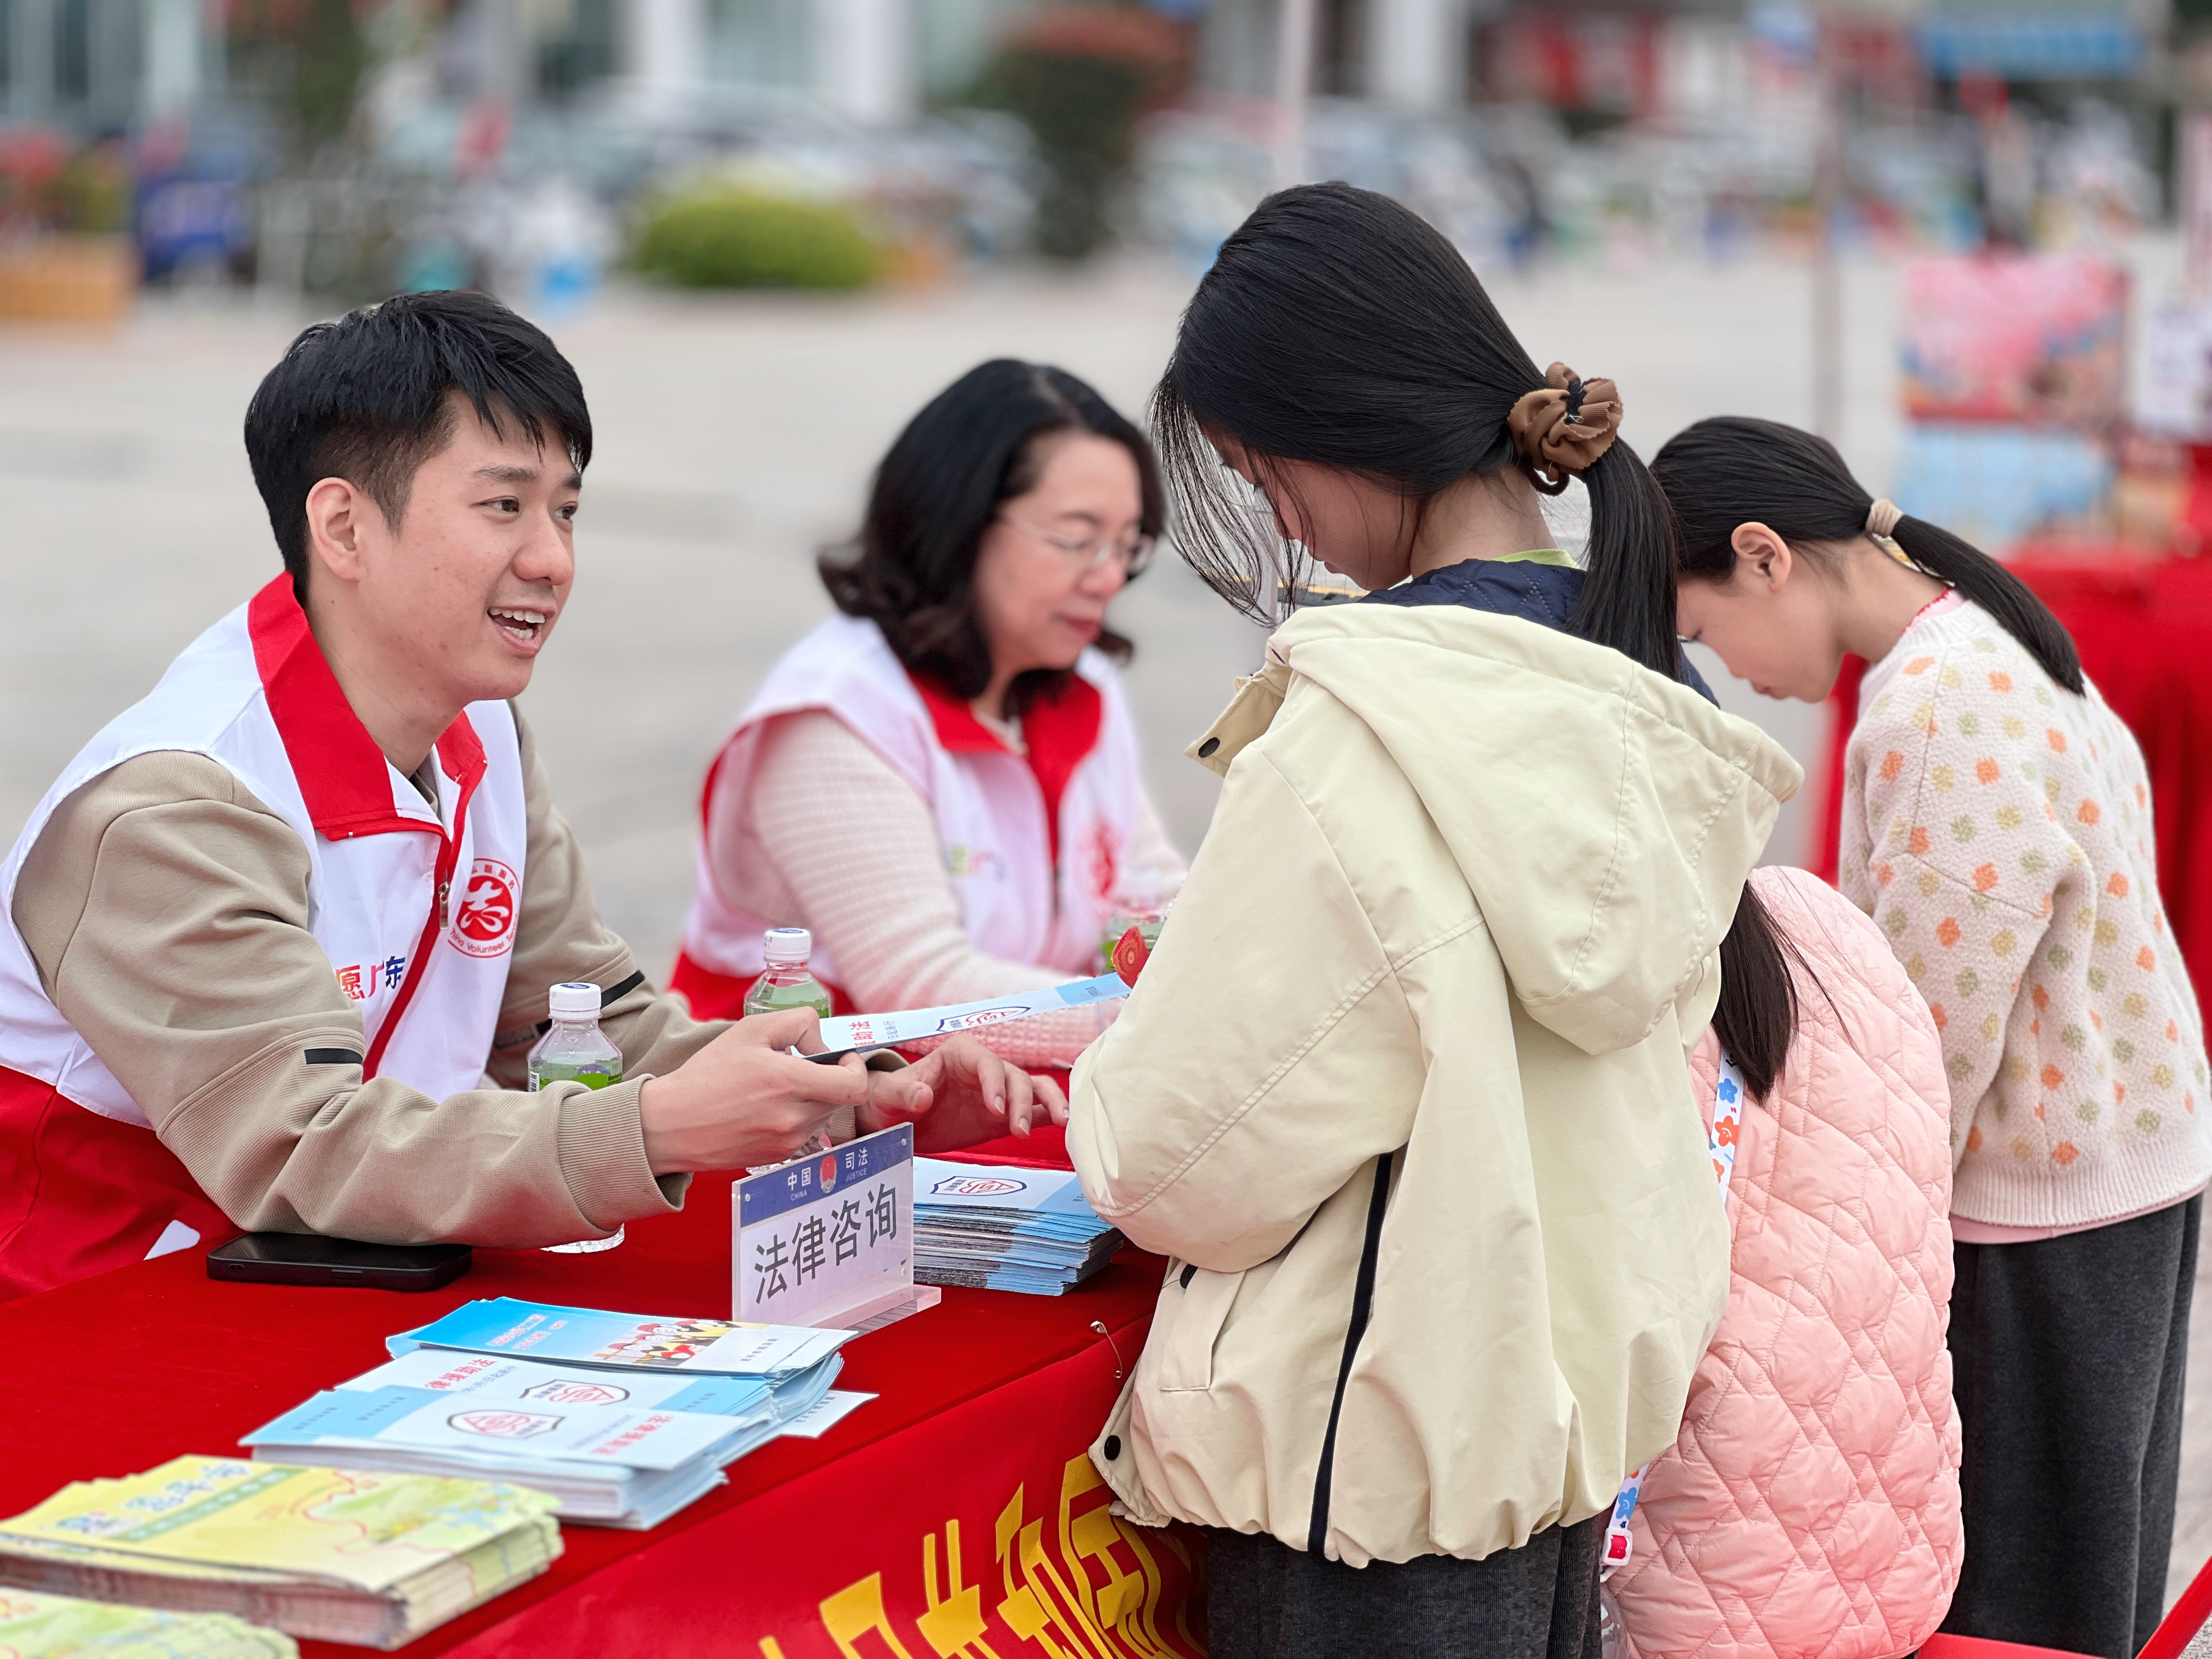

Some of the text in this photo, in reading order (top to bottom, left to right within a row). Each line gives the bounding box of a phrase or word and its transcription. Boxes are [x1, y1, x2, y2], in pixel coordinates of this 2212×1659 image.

[450, 927, 465, 947] hina
[467, 941, 505, 953] Volunteer
[787, 1147, 868, 1191] 中国 司法
[791, 1169, 867, 1201] CHINA JUSTICE
[754, 1183, 896, 1305] 法律咨询
[424, 1358, 498, 1390] 律援助法
